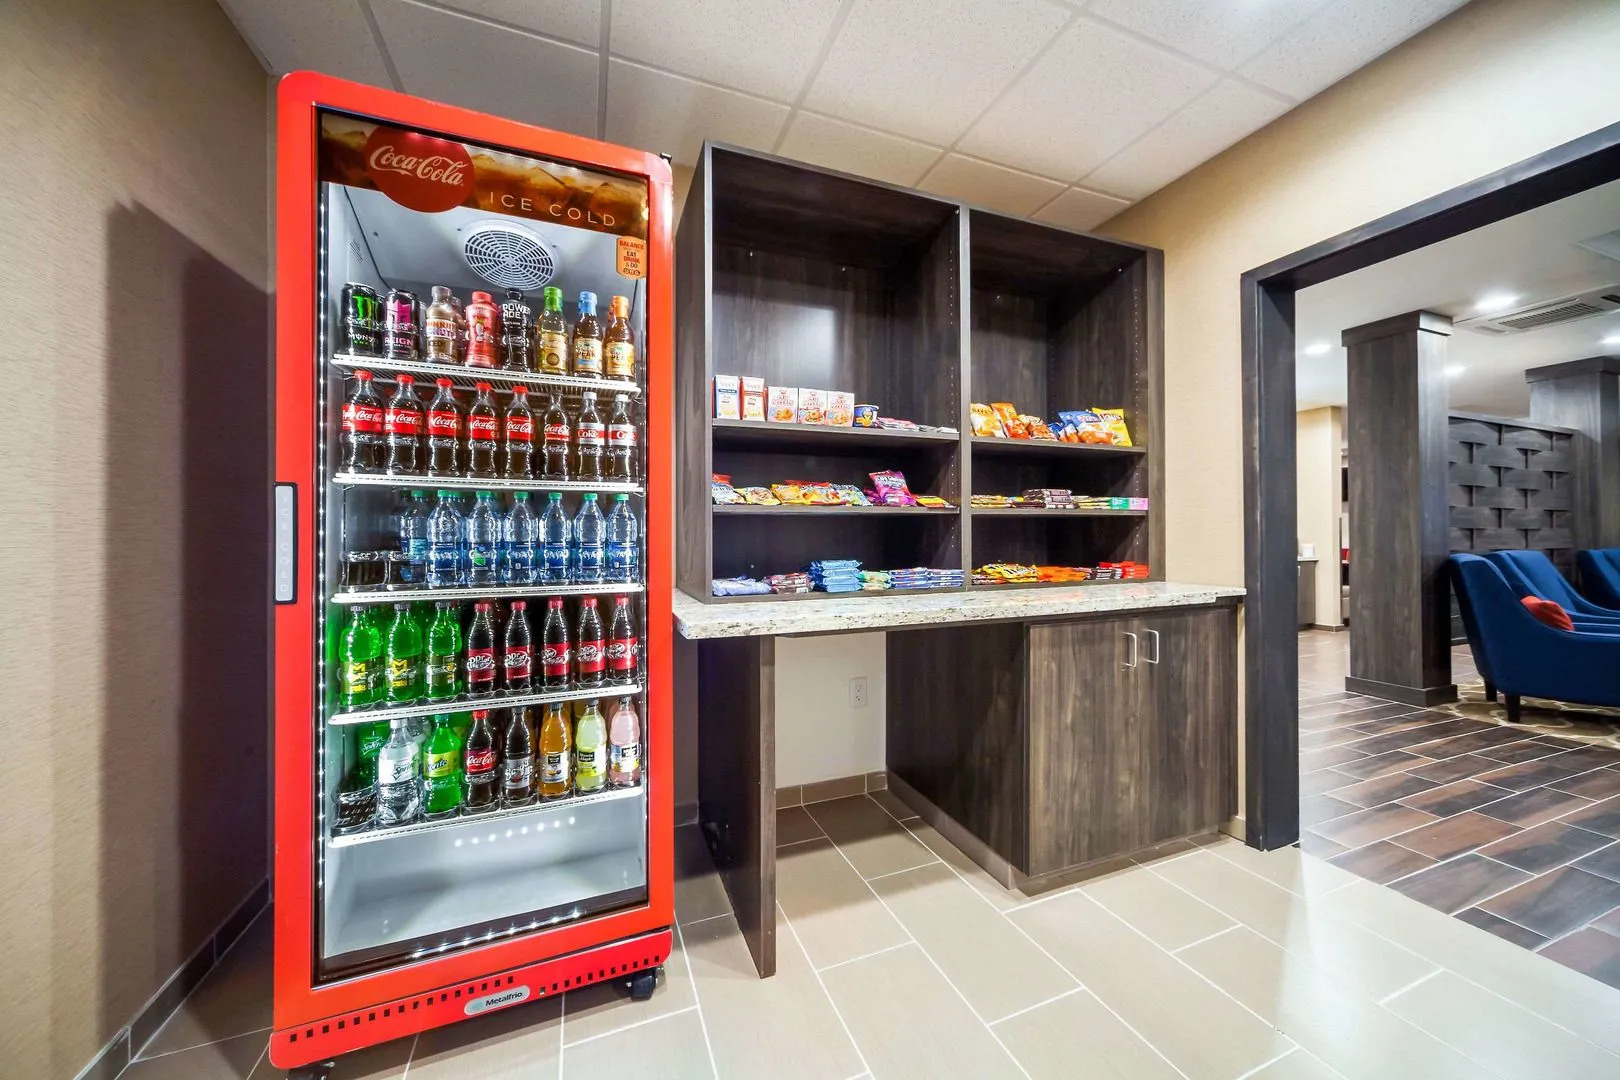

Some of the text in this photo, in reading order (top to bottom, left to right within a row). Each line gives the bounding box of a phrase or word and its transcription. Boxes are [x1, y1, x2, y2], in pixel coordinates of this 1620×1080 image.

[369, 145, 467, 187] Coca-Cola
[490, 191, 616, 227] ICE COLD
[619, 240, 645, 250] BALANCE
[502, 303, 531, 315] POWER
[502, 311, 521, 319] ADE
[384, 337, 414, 346] REIGN
[577, 429, 598, 439] Coke
[485, 991, 523, 1006] Metalfrio
